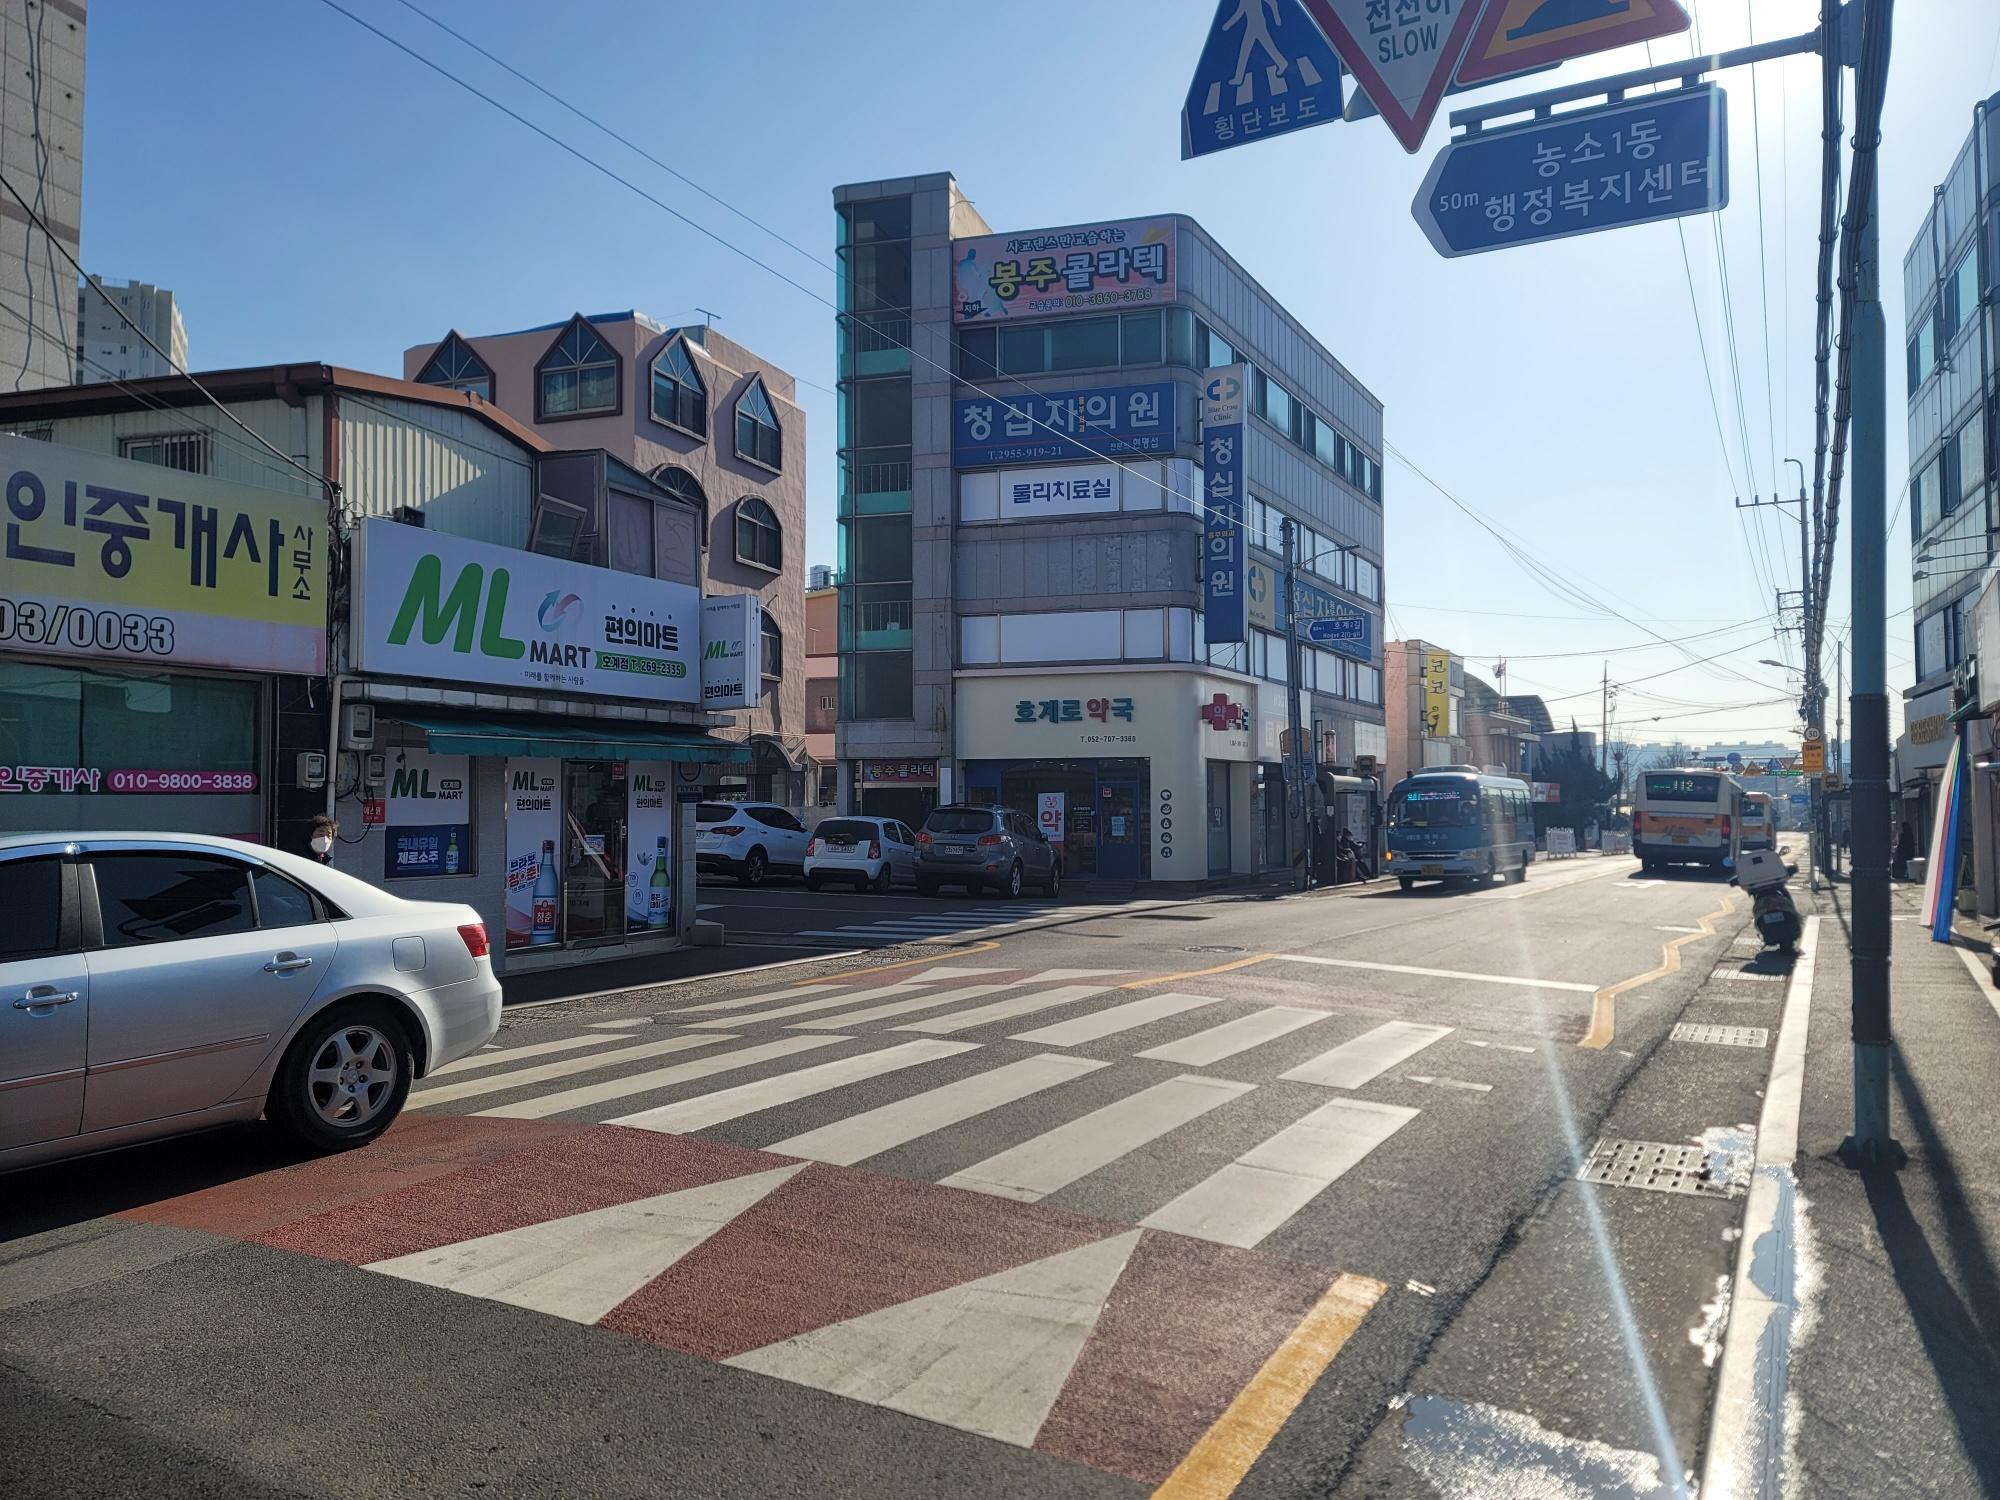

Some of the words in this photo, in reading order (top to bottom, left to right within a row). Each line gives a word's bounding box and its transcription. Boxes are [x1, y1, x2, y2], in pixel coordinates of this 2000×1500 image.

[1378, 23, 1440, 64] SLOW
[1213, 95, 1320, 141] 횡단보도
[1532, 118, 1663, 177] 농소1동
[1439, 190, 1480, 211] 50m
[1484, 155, 1715, 232] 행정복지센터
[1065, 288, 1152, 309] 010-3860-3788
[964, 391, 1160, 441] 청십자의원
[1213, 413, 1233, 422] Clinic
[1012, 478, 1112, 504] 물리치료실
[1209, 436, 1237, 598] 청십자의원
[5, 470, 286, 599] 인중개사
[292, 524, 313, 600] 사무소
[386, 553, 526, 660] ML
[604, 611, 680, 653] 편의마트
[529, 639, 591, 669] MART
[704, 639, 729, 660] ML
[602, 655, 629, 670] 호계점
[641, 660, 682, 676] 269-2335
[1429, 658, 1447, 695] 코코
[704, 683, 743, 699] 편의마트
[114, 773, 253, 789] 010-9800-3838
[390, 768, 437, 799] ML
[512, 770, 540, 791] ML
[633, 775, 654, 792] ML
[438, 791, 464, 800] MART
[516, 798, 552, 811] 편의마트
[636, 798, 664, 809] 편의마트
[1040, 809, 1062, 833] 약
[397, 850, 440, 865] 제로소주
[536, 911, 553, 923] 청춘
